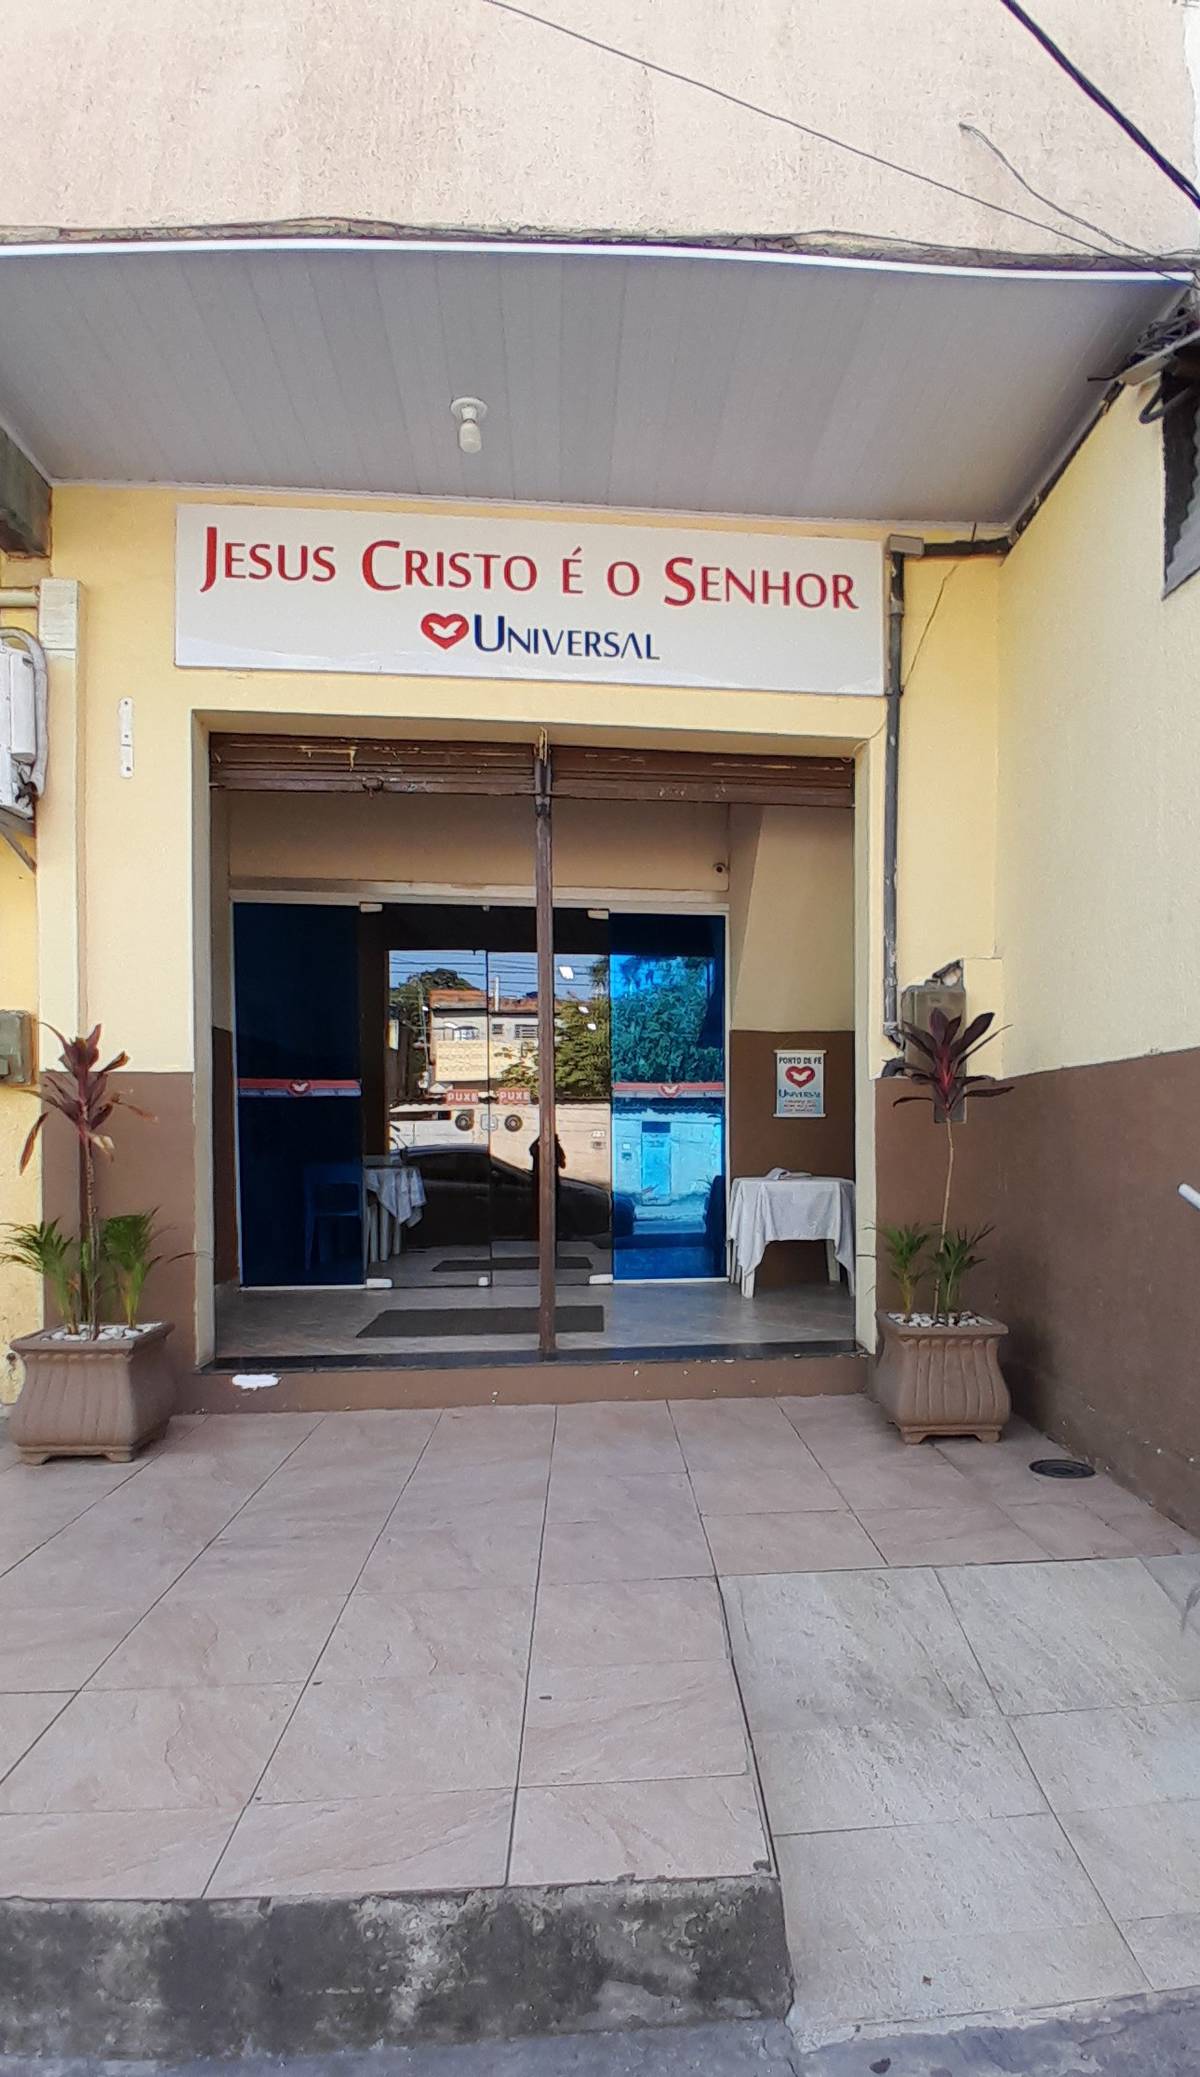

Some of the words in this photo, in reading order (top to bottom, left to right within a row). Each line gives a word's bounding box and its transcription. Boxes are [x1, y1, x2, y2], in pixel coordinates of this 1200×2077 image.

[200, 526, 336, 593] JESUS
[361, 540, 538, 592] CRISTO
[562, 546, 584, 595] É
[606, 561, 641, 597] O
[663, 556, 860, 610] SENHOR
[474, 614, 661, 661] UNIVERSAL
[447, 1091, 479, 1102] PUXE
[499, 1091, 530, 1101] PUXE
